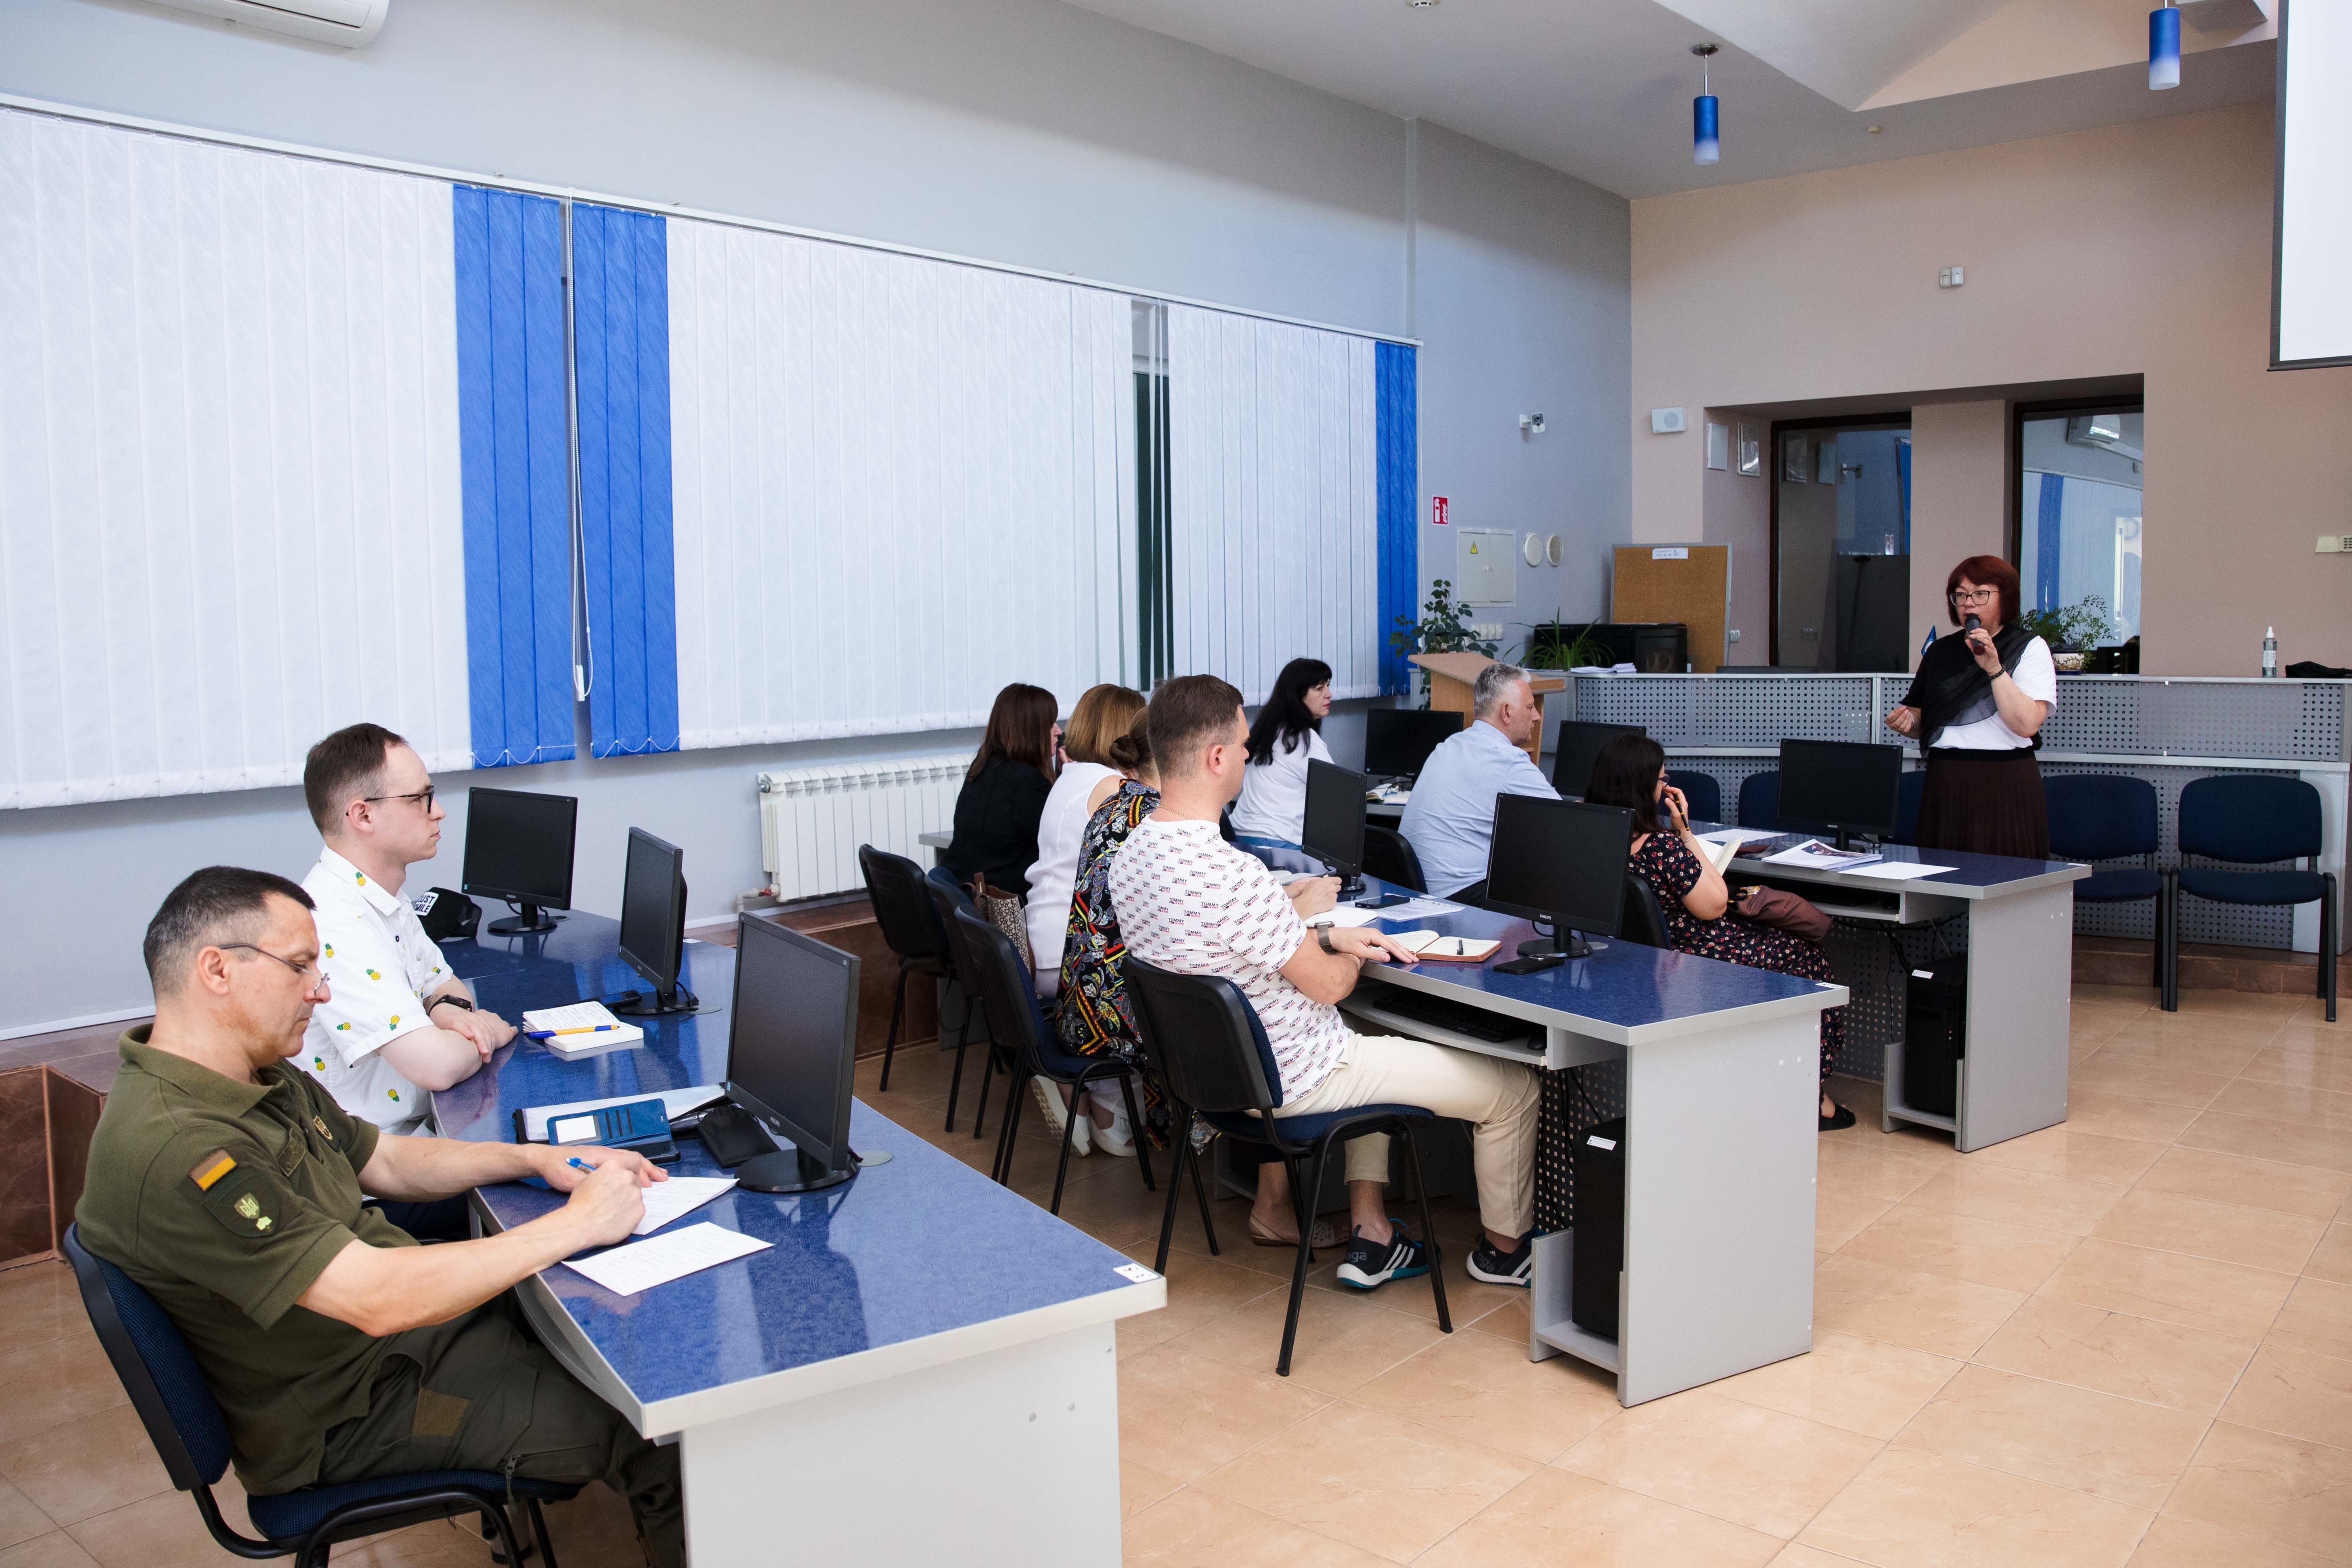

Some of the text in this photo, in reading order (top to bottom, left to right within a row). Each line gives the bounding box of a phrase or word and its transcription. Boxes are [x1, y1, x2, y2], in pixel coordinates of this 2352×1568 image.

[1229, 878, 1244, 890] TOMMY
[1250, 875, 1263, 886] TOMMY
[1243, 893, 1258, 906] TOMMY
[1263, 891, 1275, 902] TOMMY
[1221, 897, 1237, 909] TOMMY
[1234, 912, 1250, 924] TOMMY
[1256, 909, 1270, 921] TOMMY
[1274, 906, 1285, 918] TOMMY
[1247, 927, 1263, 939] TOMMY
[1267, 923, 1280, 936] TOMMY
[1284, 921, 1293, 933] TOMMY
[1226, 930, 1242, 942] TOMMY
[1239, 945, 1254, 956] TOMMY
[1259, 942, 1274, 954] TOMMY
[1211, 963, 1232, 972] TOMMY
[1233, 963, 1249, 973] TOMMY
[1271, 957, 1285, 969] TOMMY
[1282, 999, 1294, 1008] TOMMY
[1297, 1000, 1307, 1009] TOMMY
[1289, 1016, 1300, 1026] TOMMY
[1292, 1046, 1304, 1057] TOMMY
[1309, 1042, 1319, 1055] TOMMY
[1335, 1049, 1345, 1061] TOMMY
[1302, 1060, 1313, 1073] TOMMY
[1317, 1055, 1329, 1068] TOMMY
[1312, 1074, 1325, 1087] TOMMY
[1296, 1088, 1312, 1098] TOMMY
